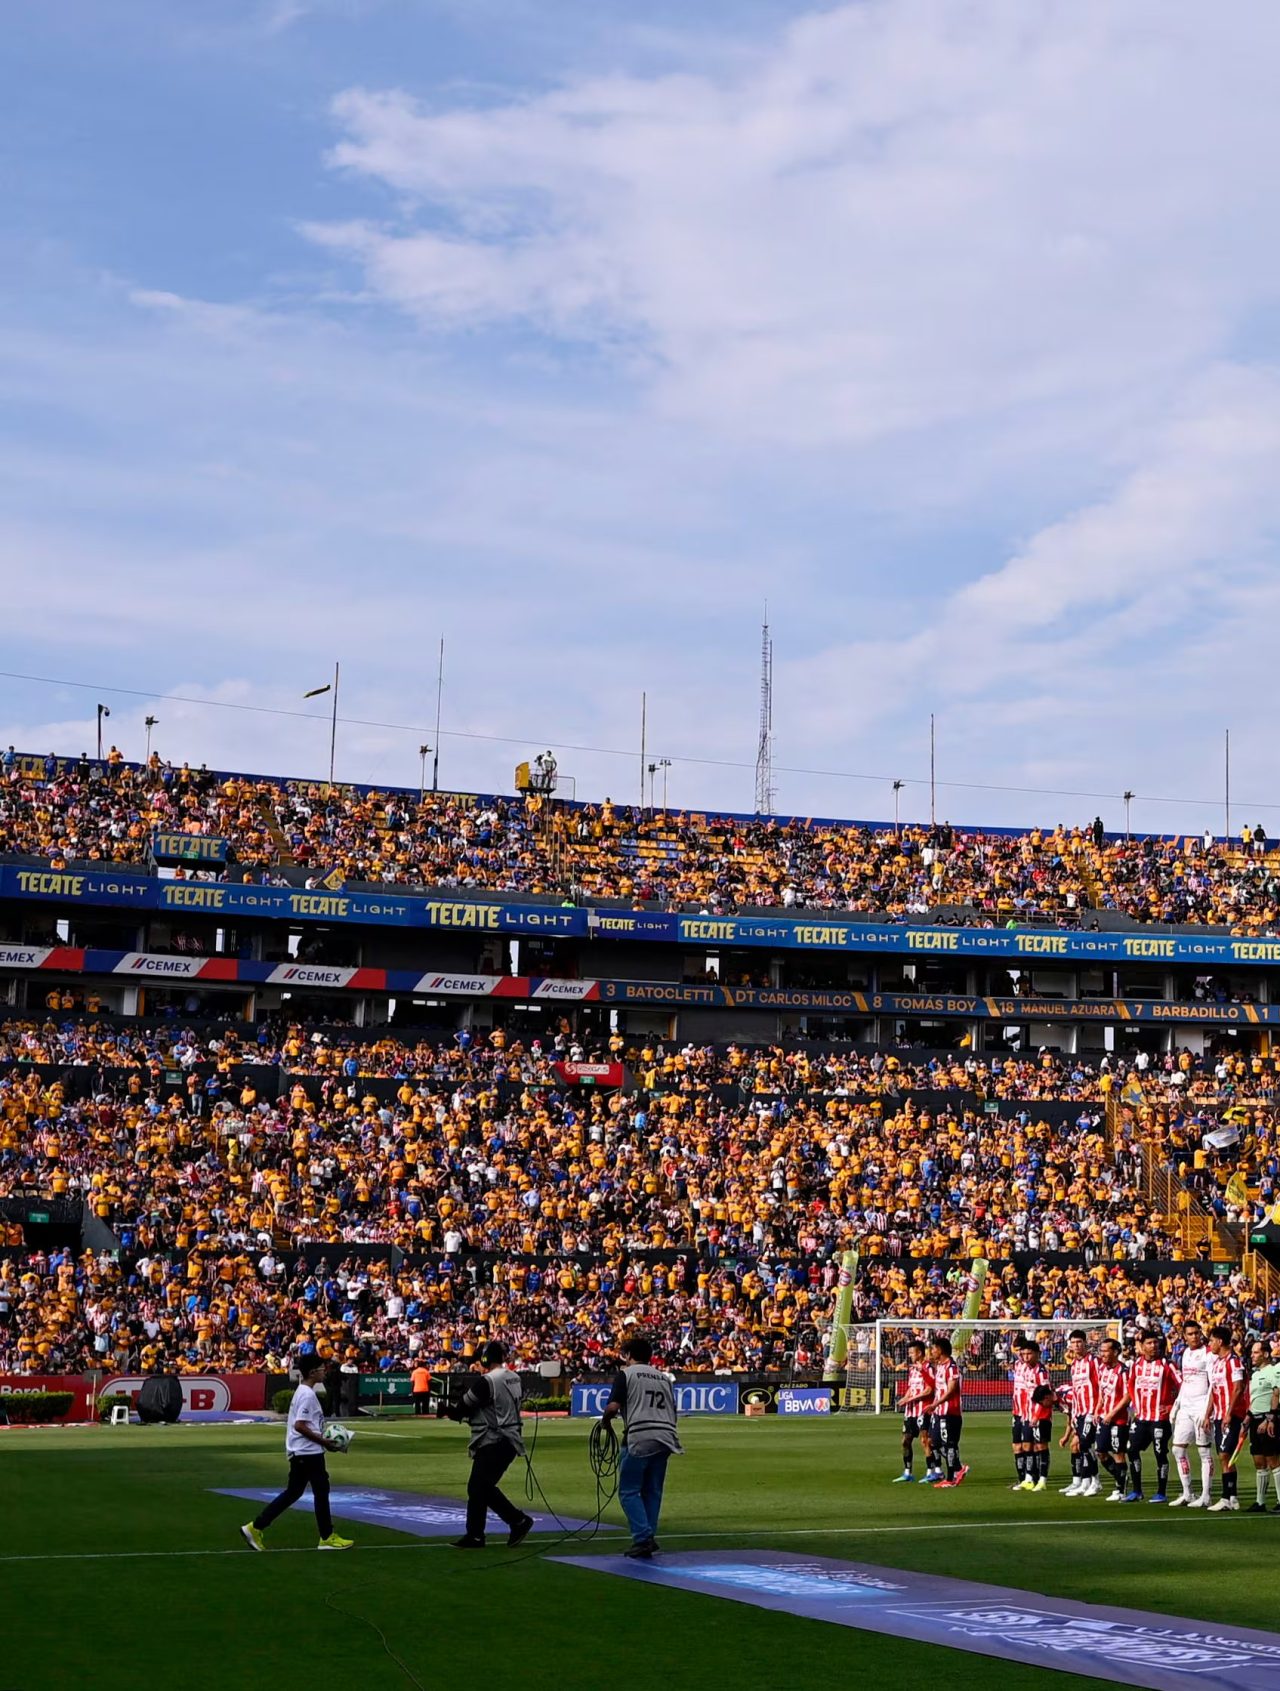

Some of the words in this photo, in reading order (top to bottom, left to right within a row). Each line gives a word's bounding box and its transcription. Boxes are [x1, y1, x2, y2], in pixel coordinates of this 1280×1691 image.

[156, 834, 222, 858] TECATE
[18, 872, 83, 895] TECATE
[88, 882, 147, 895] LIGHT
[165, 886, 222, 906] TECATE
[229, 895, 284, 907] LIGHT
[290, 895, 348, 915] TECATE
[353, 904, 406, 916] LIGHT
[427, 902, 501, 927] TECATE
[506, 913, 572, 925] LIGHT
[601, 918, 633, 929] TECATE
[682, 920, 733, 938] TECATE
[739, 928, 787, 938] LIGHT
[795, 927, 846, 944] TECATE
[851, 933, 899, 942] LIGHT
[907, 932, 957, 948] TECATE
[962, 938, 1009, 947] LIGHT
[1017, 935, 1066, 952] TECATE
[1072, 942, 1118, 951] LIGHT
[1125, 939, 1174, 956] TECATE
[1179, 945, 1225, 954] LIGHT
[1232, 943, 1280, 959] TECATE
[146, 960, 190, 972] CEMEX
[297, 971, 341, 982] CEMEX
[444, 979, 485, 991] CEMEX
[552, 985, 584, 995] CEMEX
[607, 985, 615, 996] 3
[626, 986, 713, 1002] BATOCLETTI
[737, 991, 755, 1003] DT
[759, 992, 808, 1005] CARLOS
[812, 993, 851, 1006] MILOC
[873, 997, 881, 1007] 8
[947, 999, 975, 1011] BOY
[1021, 1003, 1067, 1015] MANUEL
[1071, 1004, 1115, 1016] AZUARA
[1135, 1004, 1142, 1015] 7
[1152, 1005, 1238, 1018] BARBADILLO
[1262, 1008, 1268, 1019] 1
[636, 1372, 669, 1382] PRENSA
[645, 1391, 666, 1409] 72
[778, 1391, 793, 1400] LIGA
[784, 1400, 814, 1412] BBVA
